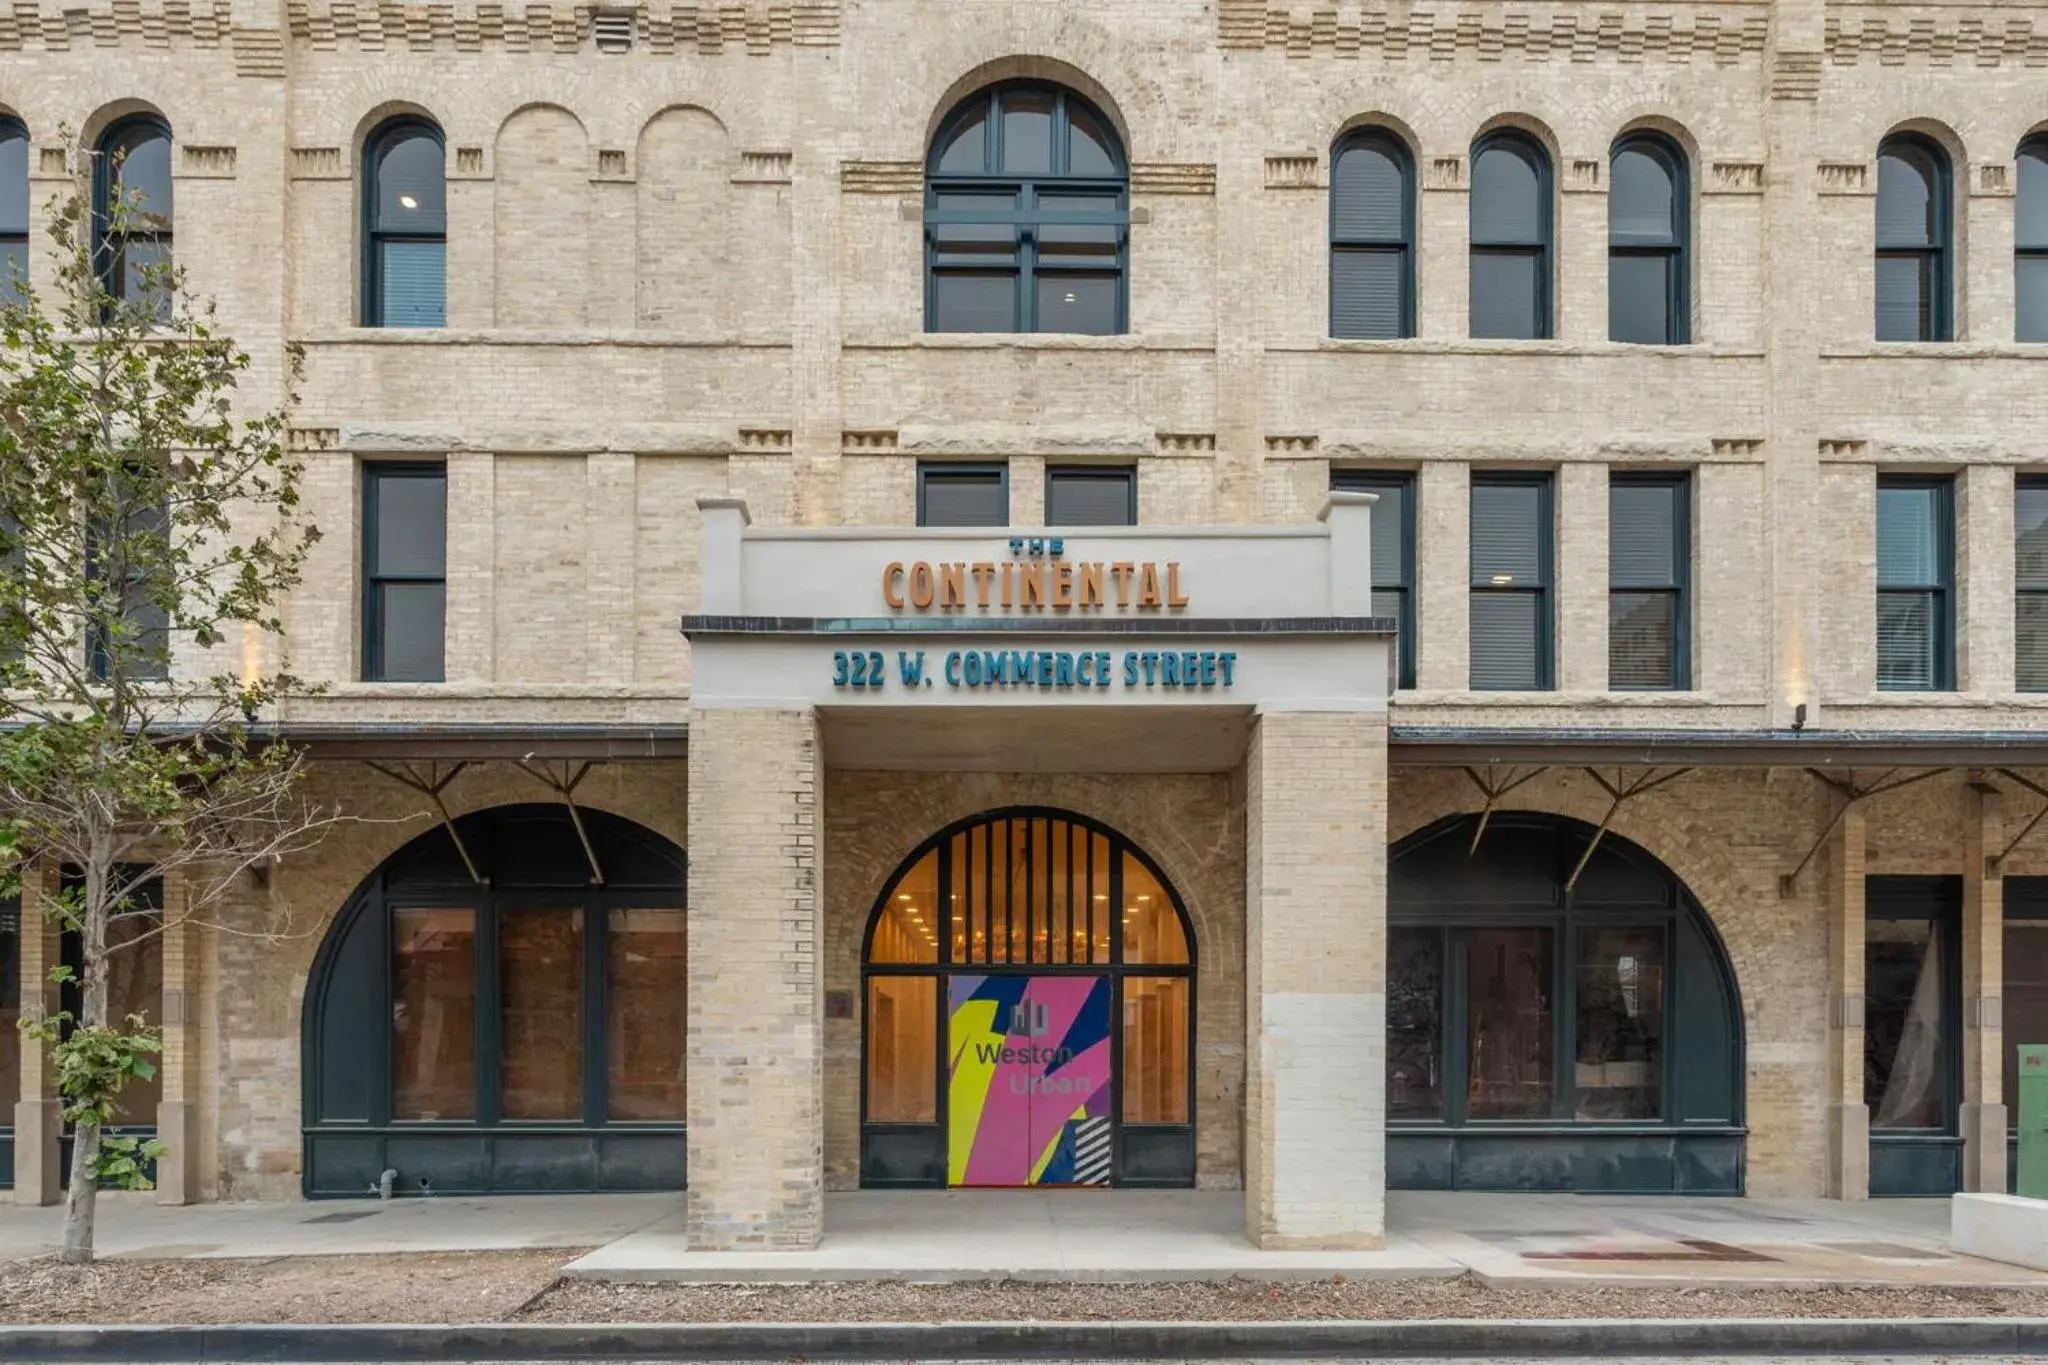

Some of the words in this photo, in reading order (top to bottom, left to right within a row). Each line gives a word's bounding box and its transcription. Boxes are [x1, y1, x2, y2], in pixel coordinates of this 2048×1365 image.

[1009, 536, 1065, 556] THE
[883, 561, 1190, 609] CONTINENTAL
[833, 651, 885, 687] 322
[898, 651, 932, 687] W.
[945, 651, 1112, 687] COMMERCE
[1124, 651, 1237, 687] STREET
[976, 1043, 1073, 1064] Weston
[1009, 1074, 1091, 1095] Urban
